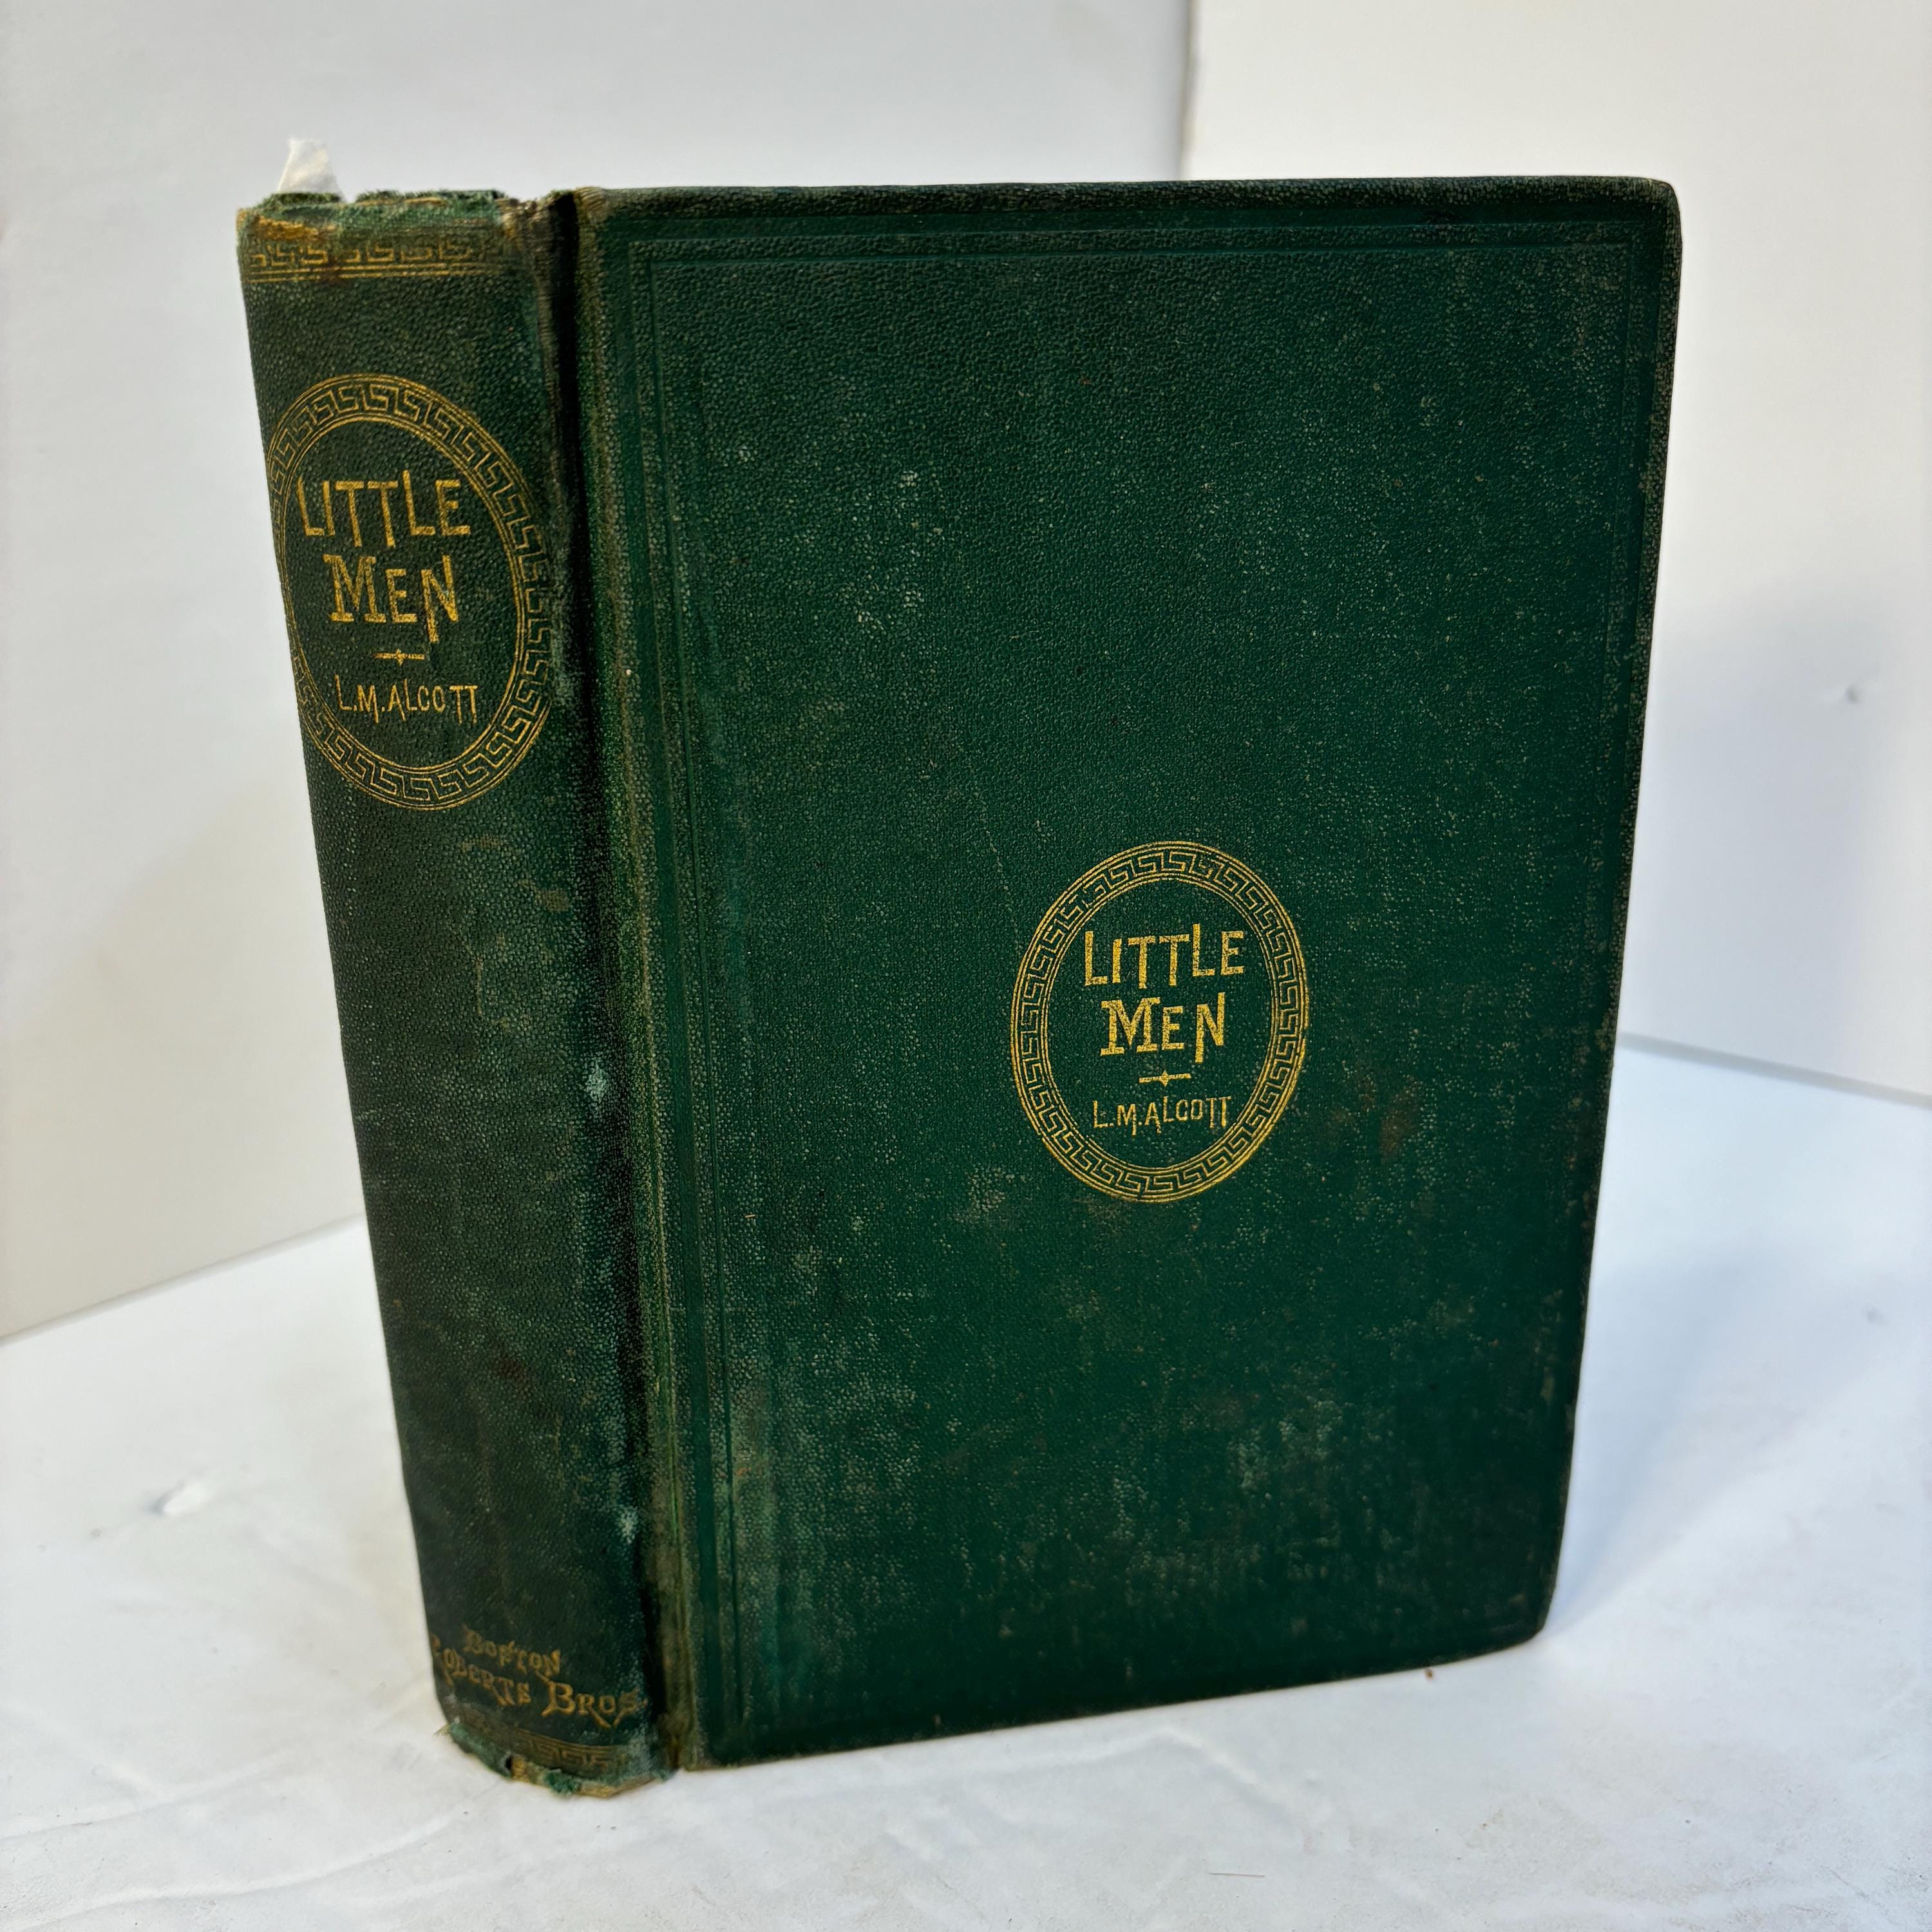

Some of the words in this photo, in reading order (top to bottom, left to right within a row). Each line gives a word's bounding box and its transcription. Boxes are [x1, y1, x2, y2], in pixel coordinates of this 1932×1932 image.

[296, 469, 471, 548] LITTLE
[323, 554, 459, 643] MEN
[1084, 923, 1245, 989] LITTLE
[1100, 992, 1226, 1064] MEN
